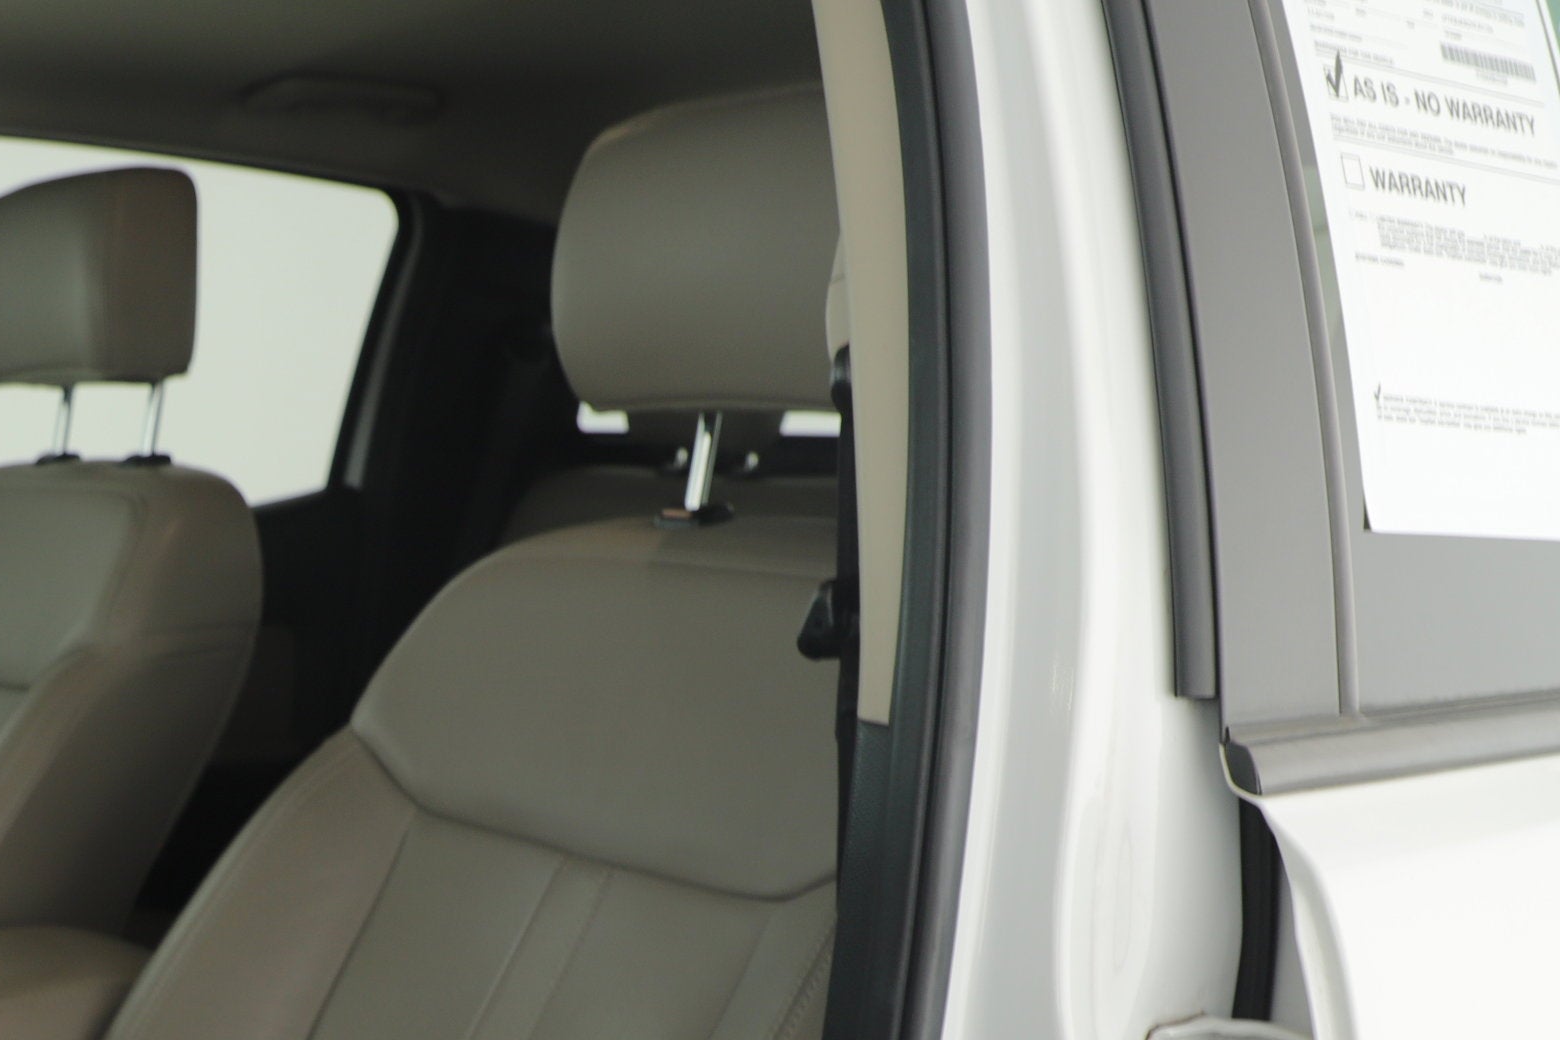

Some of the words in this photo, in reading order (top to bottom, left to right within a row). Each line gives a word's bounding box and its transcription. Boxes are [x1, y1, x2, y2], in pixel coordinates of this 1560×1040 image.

[1354, 75, 1377, 103] AS
[1381, 80, 1400, 108] IS
[1414, 88, 1441, 117] NO
[1445, 95, 1535, 137] WARRANTY
[1369, 166, 1467, 208] WARRANTY
